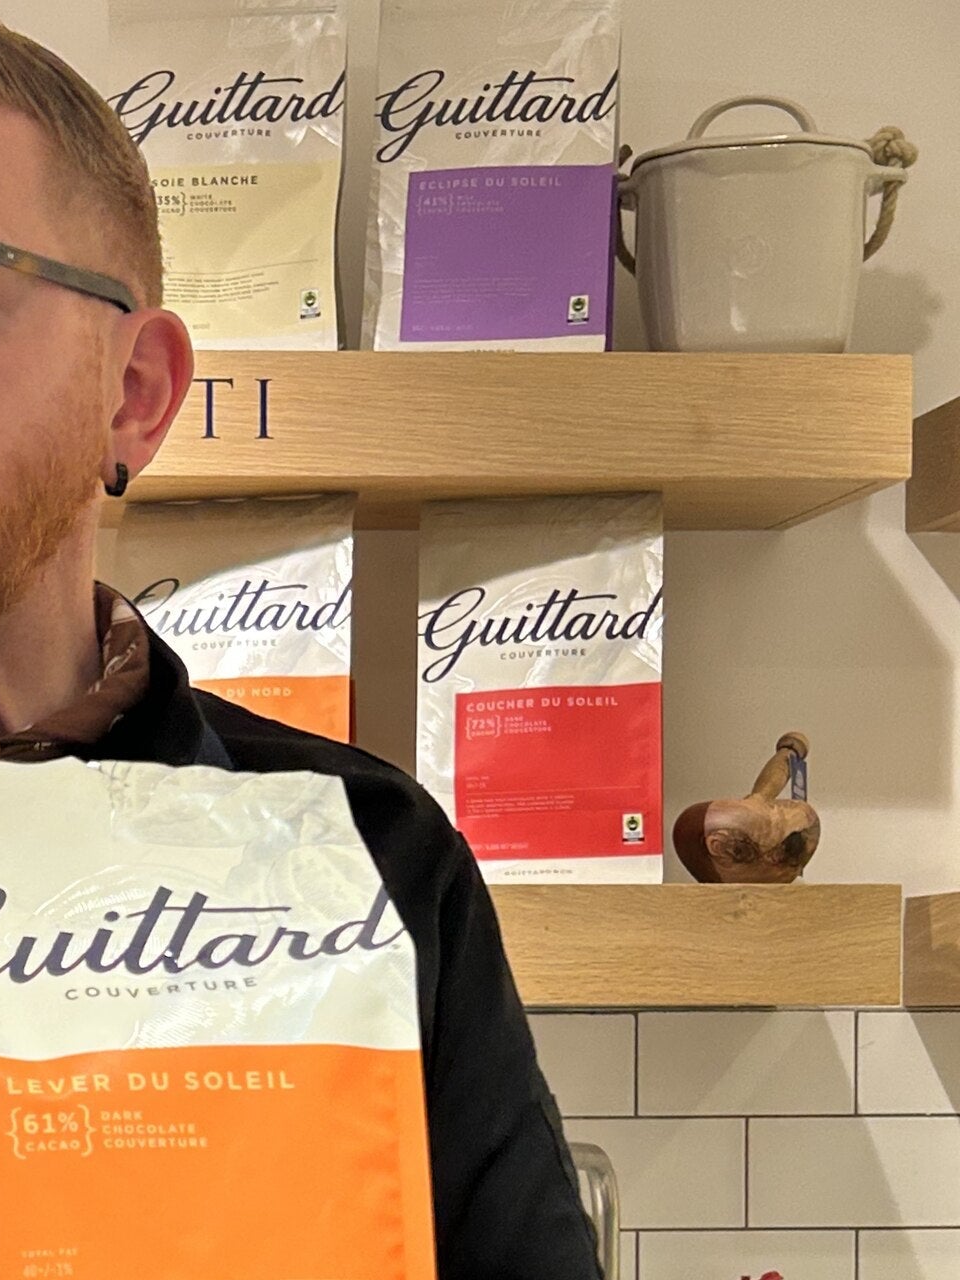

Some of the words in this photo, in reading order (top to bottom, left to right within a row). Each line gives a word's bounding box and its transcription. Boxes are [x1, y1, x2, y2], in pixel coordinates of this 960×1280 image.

[107, 69, 346, 146] Guittard
[374, 69, 618, 163] Guittard
[187, 129, 272, 140] COUVERTURE
[455, 129, 542, 140] COUVERTURE
[151, 178, 185, 187] SOIE
[192, 175, 258, 187] BLANCHE
[420, 178, 478, 190] ECLIPSE
[485, 177, 505, 187] DU
[511, 177, 561, 187] SOLEIL
[417, 587, 664, 683] Guittard
[192, 639, 277, 650] COUVERTURE
[500, 648, 586, 660] COUVERTURE
[252, 687, 292, 697] NORD
[466, 698, 534, 712] COUCHER
[541, 697, 561, 707] DU
[567, 696, 618, 707] SOLEIL
[471, 718, 495, 729] 72%
[65, 976, 258, 1001] COUVERTURE
[6, 1073, 111, 1095] LEVER
[128, 1072, 169, 1092] DU
[184, 1071, 295, 1091] SOLEIL
[100, 1110, 143, 1121] DARK
[23, 1112, 79, 1135] 61%
[102, 1124, 196, 1134] CHOCOLATE
[25, 1139, 81, 1152] CACAO
[103, 1137, 208, 1148] COUVERTURE
